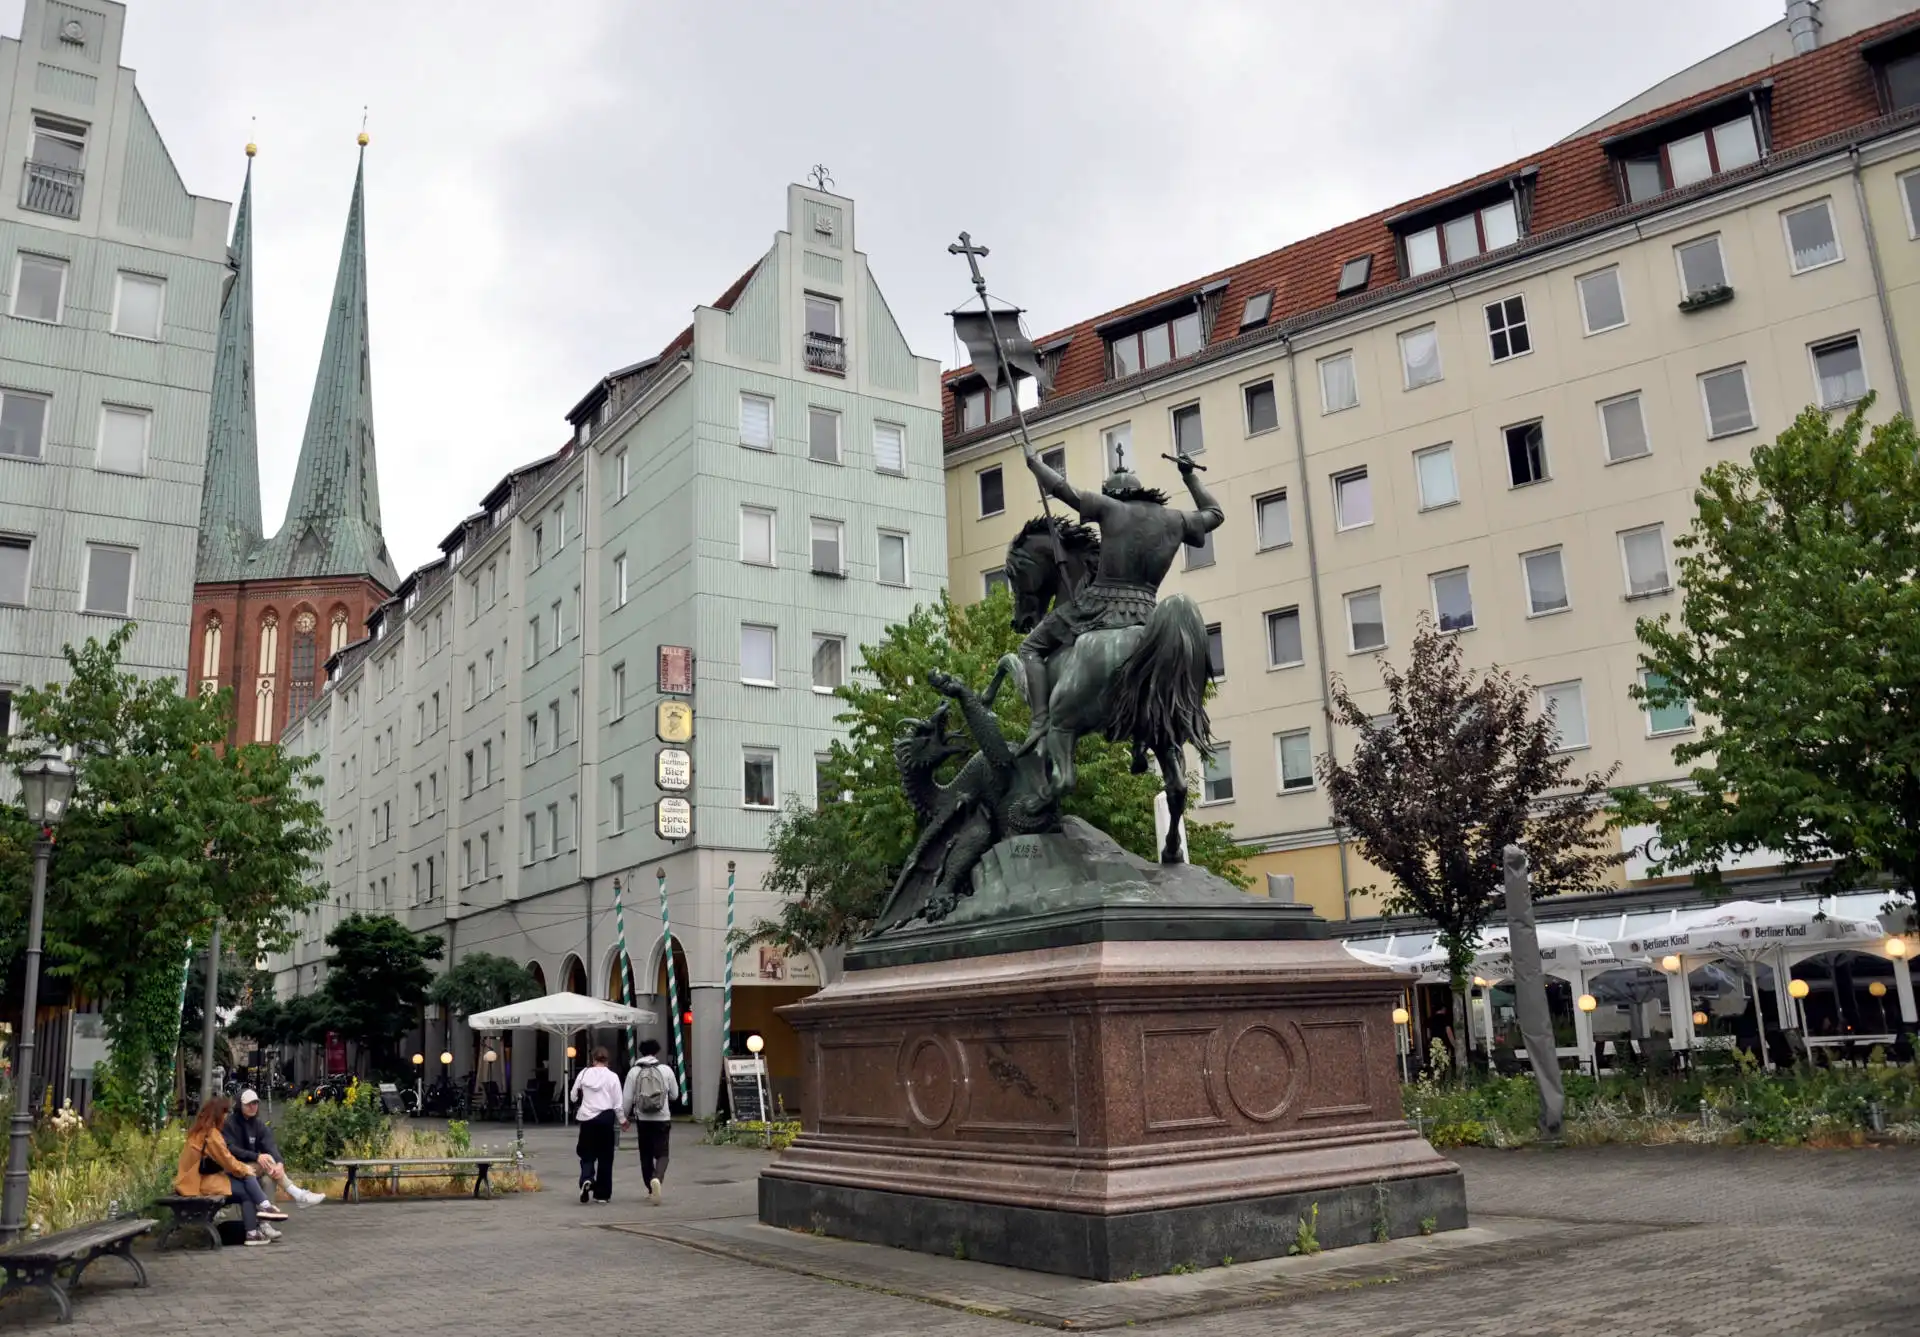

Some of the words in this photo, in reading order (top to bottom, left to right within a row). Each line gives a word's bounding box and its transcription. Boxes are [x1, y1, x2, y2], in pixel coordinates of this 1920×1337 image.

[664, 767, 685, 777] Bier
[661, 777, 689, 786] Stube
[1755, 925, 1784, 938] Berliner
[1784, 923, 1806, 937] Kindl
[1643, 937, 1669, 950] Berliner
[1669, 933, 1690, 946] Kindl
